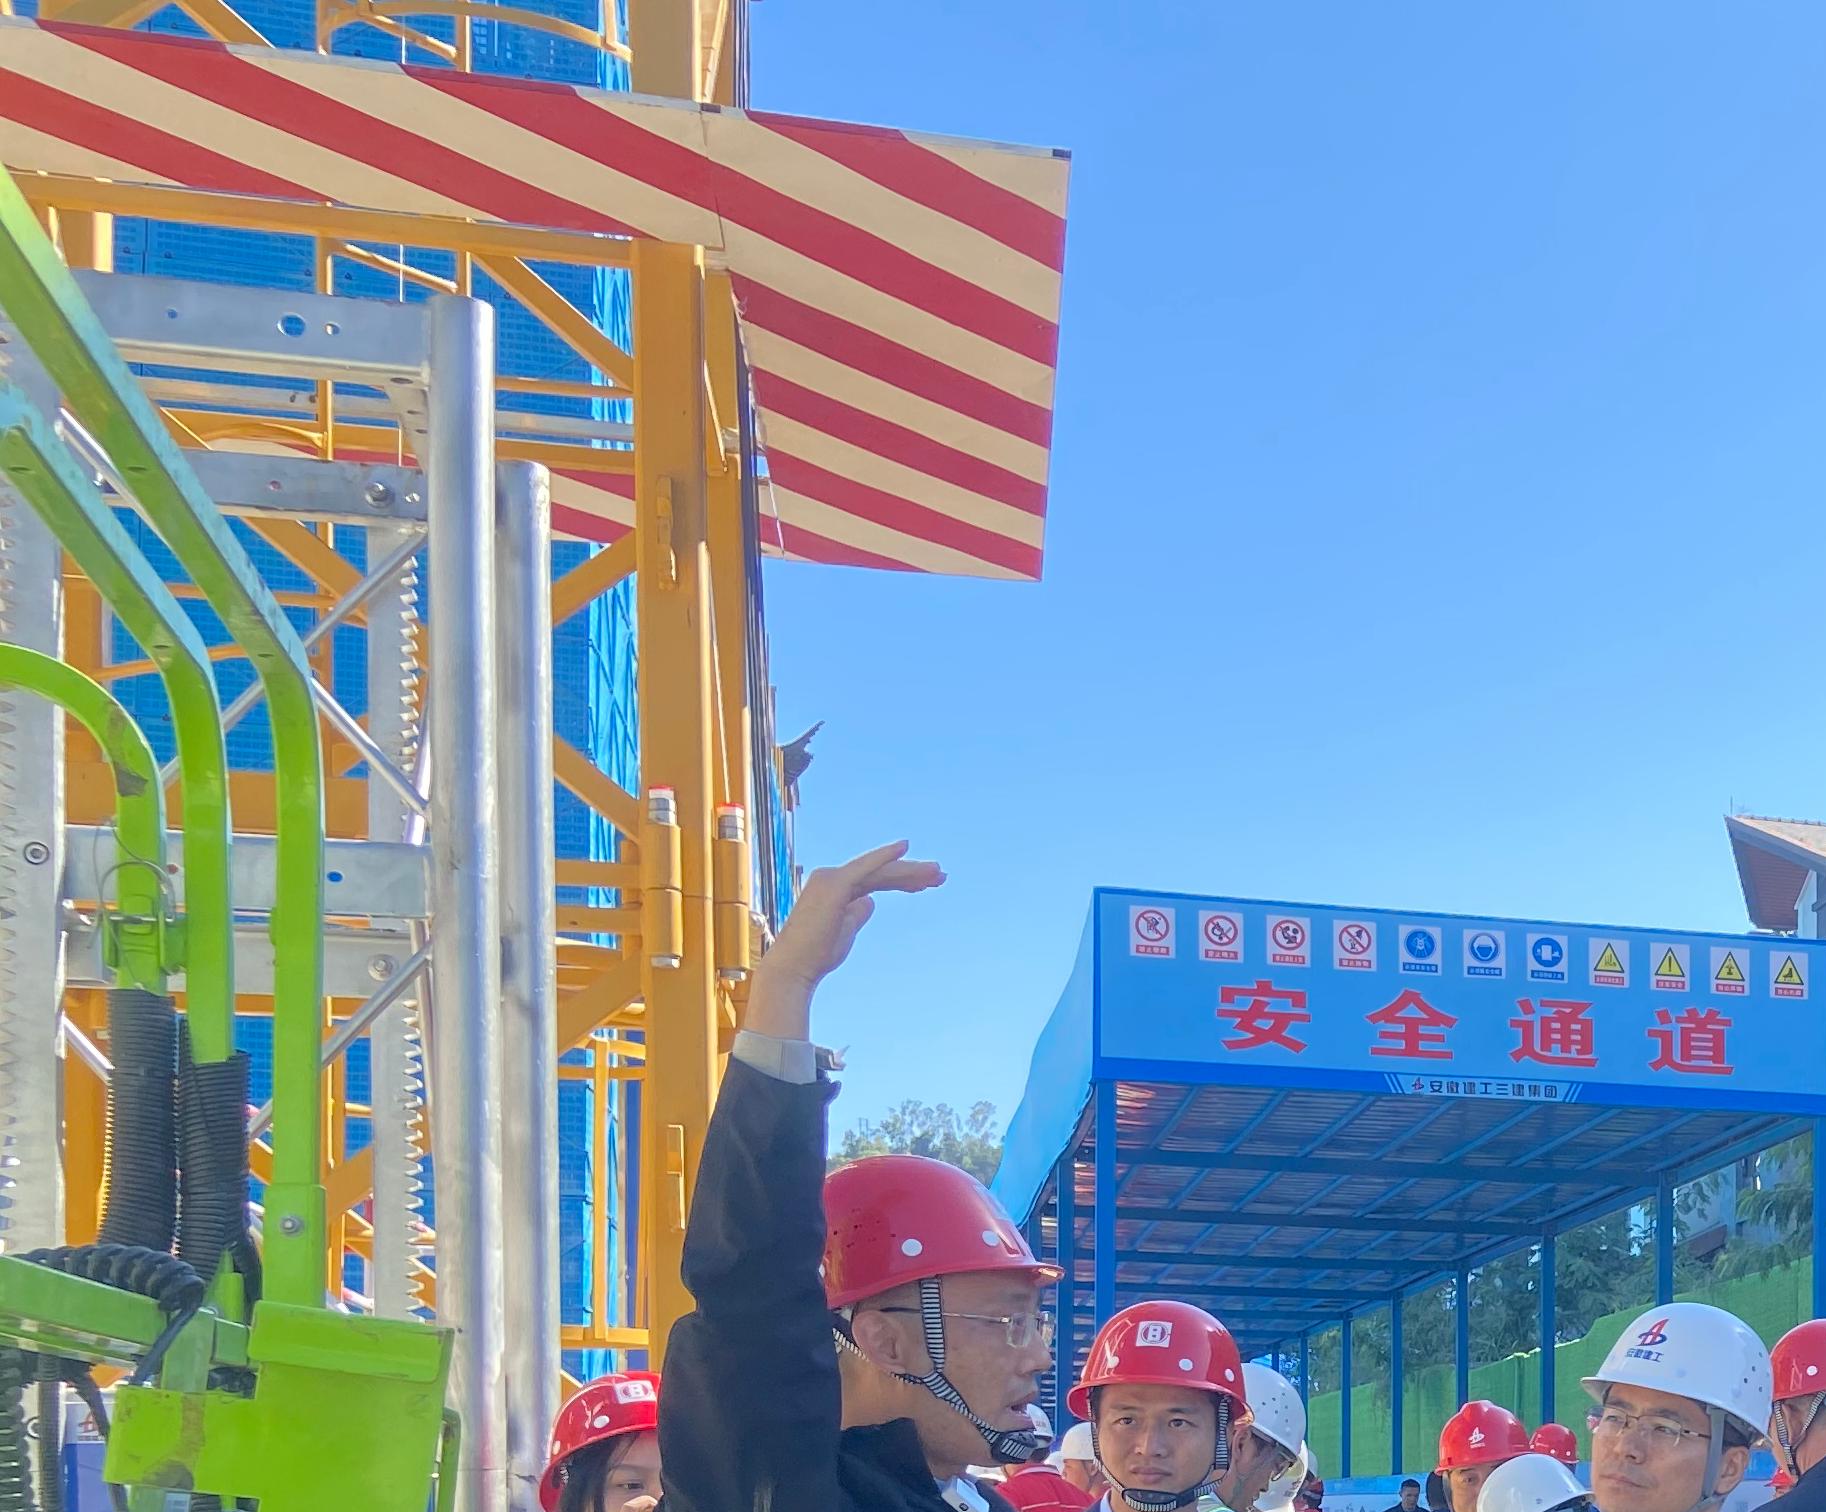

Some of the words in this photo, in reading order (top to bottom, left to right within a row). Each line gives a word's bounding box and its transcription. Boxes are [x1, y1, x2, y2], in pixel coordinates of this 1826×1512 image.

[1216, 980, 1735, 1075] 安全通道
[1429, 1080, 1558, 1098] 安徽建工三建集团
